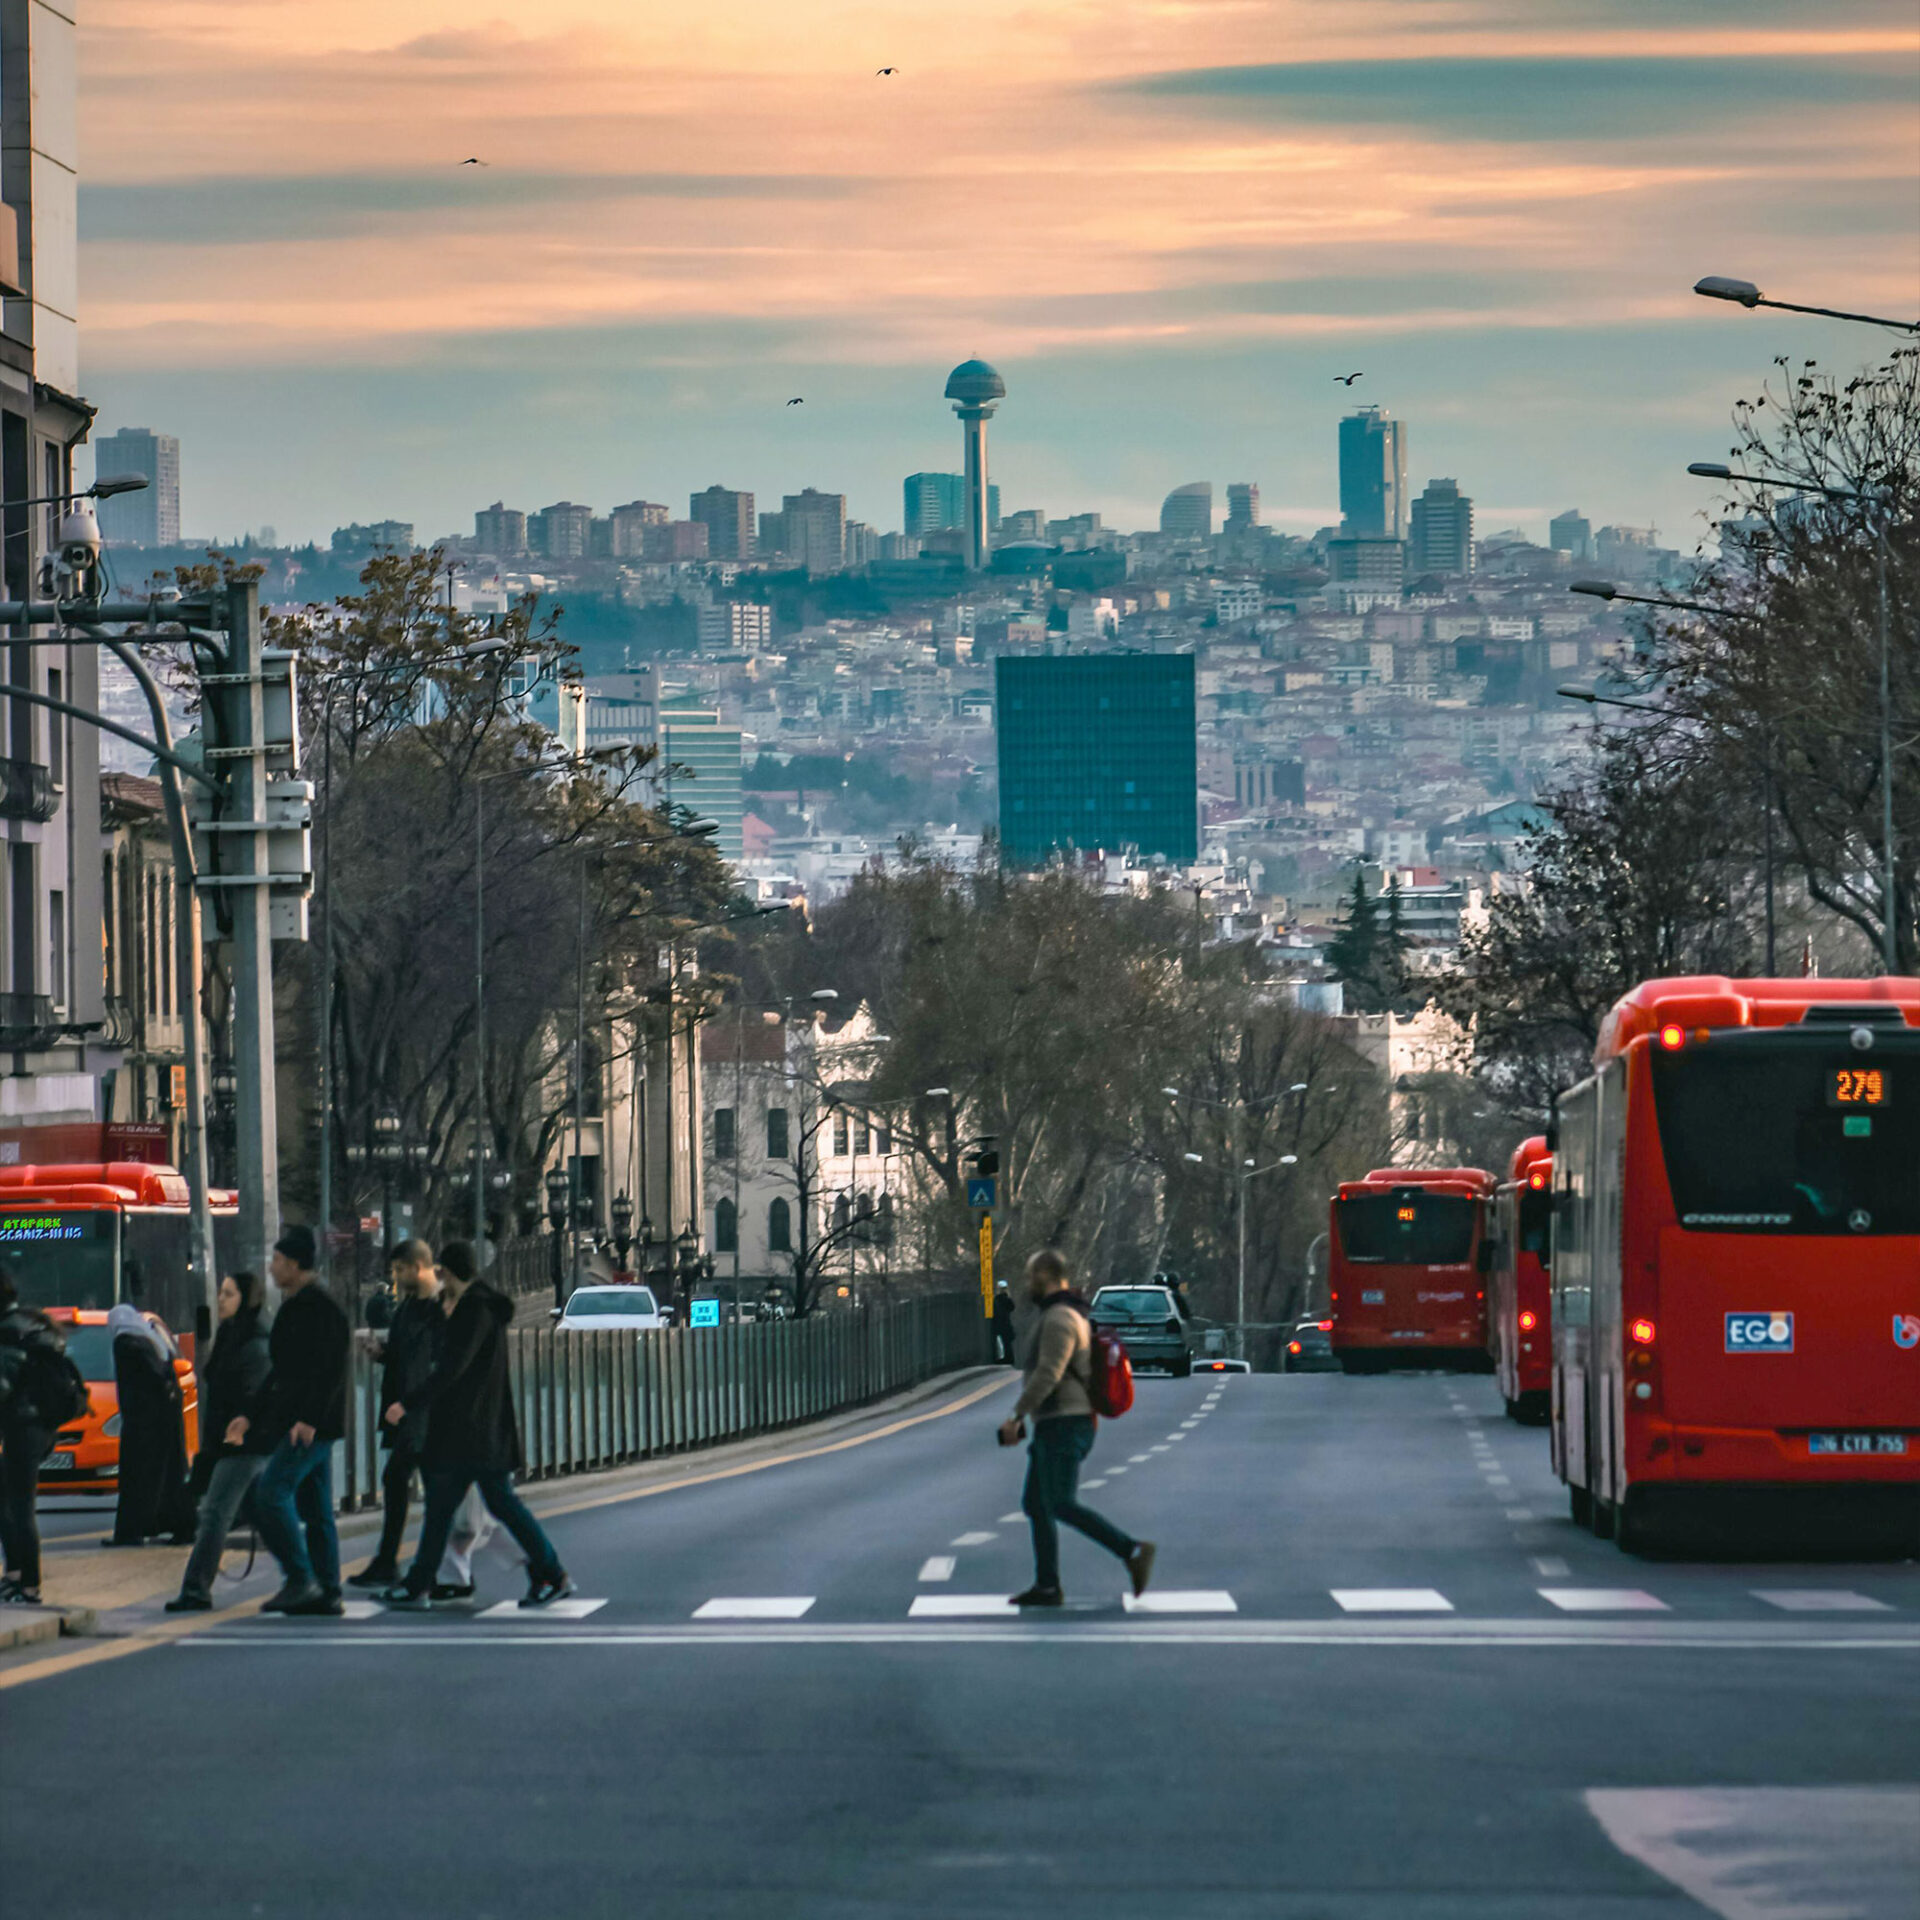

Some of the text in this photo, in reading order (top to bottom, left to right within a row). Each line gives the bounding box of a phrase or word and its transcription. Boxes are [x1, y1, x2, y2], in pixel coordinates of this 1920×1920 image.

[108, 1124, 163, 1133] AKBANK
[1682, 1213, 1791, 1224] CONECTO
[1730, 1320, 1789, 1343] EGO
